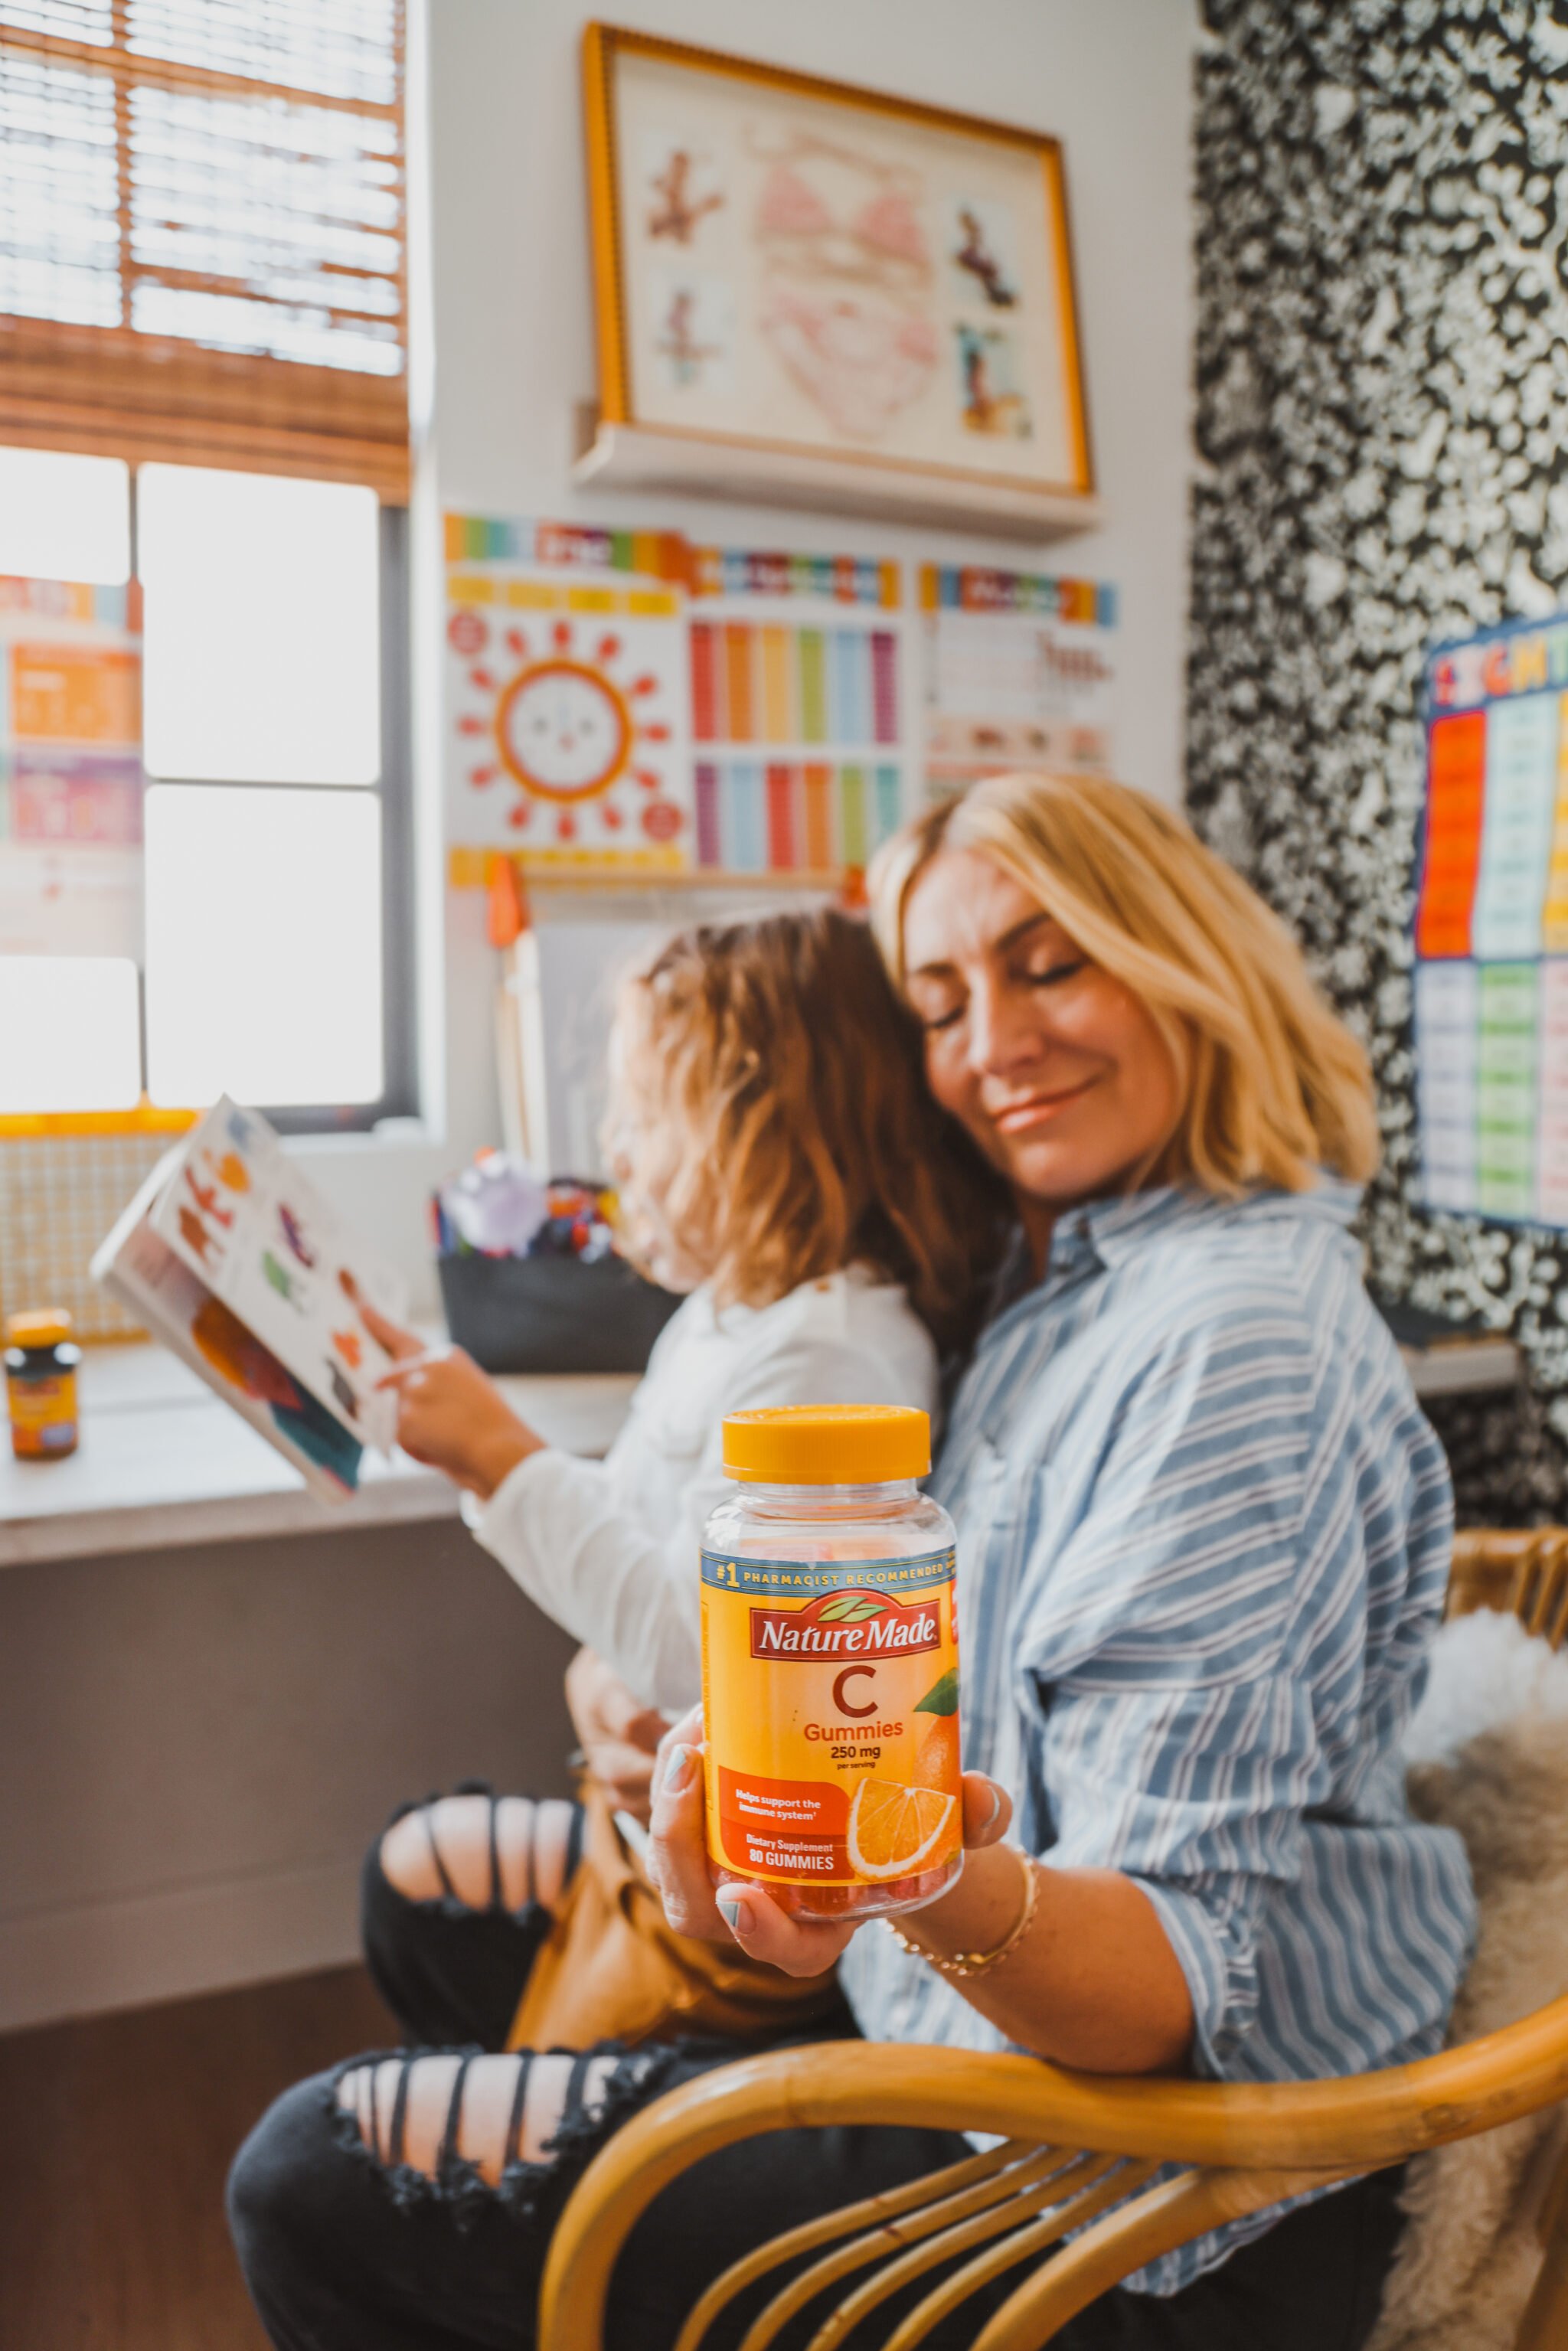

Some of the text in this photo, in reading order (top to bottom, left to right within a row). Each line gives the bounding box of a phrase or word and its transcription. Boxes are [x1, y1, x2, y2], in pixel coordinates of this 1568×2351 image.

[717, 1562, 943, 1588] #1 PHARMACIST RECOMMENDED
[832, 1665, 879, 1718] C
[804, 1721, 903, 1742] Gummies
[831, 1746, 881, 1759] 250 mg
[736, 1788, 822, 1809] Helps support the
[746, 1833, 834, 1853] Dietary Supplement
[750, 1848, 835, 1870] 80 GUMMIES
